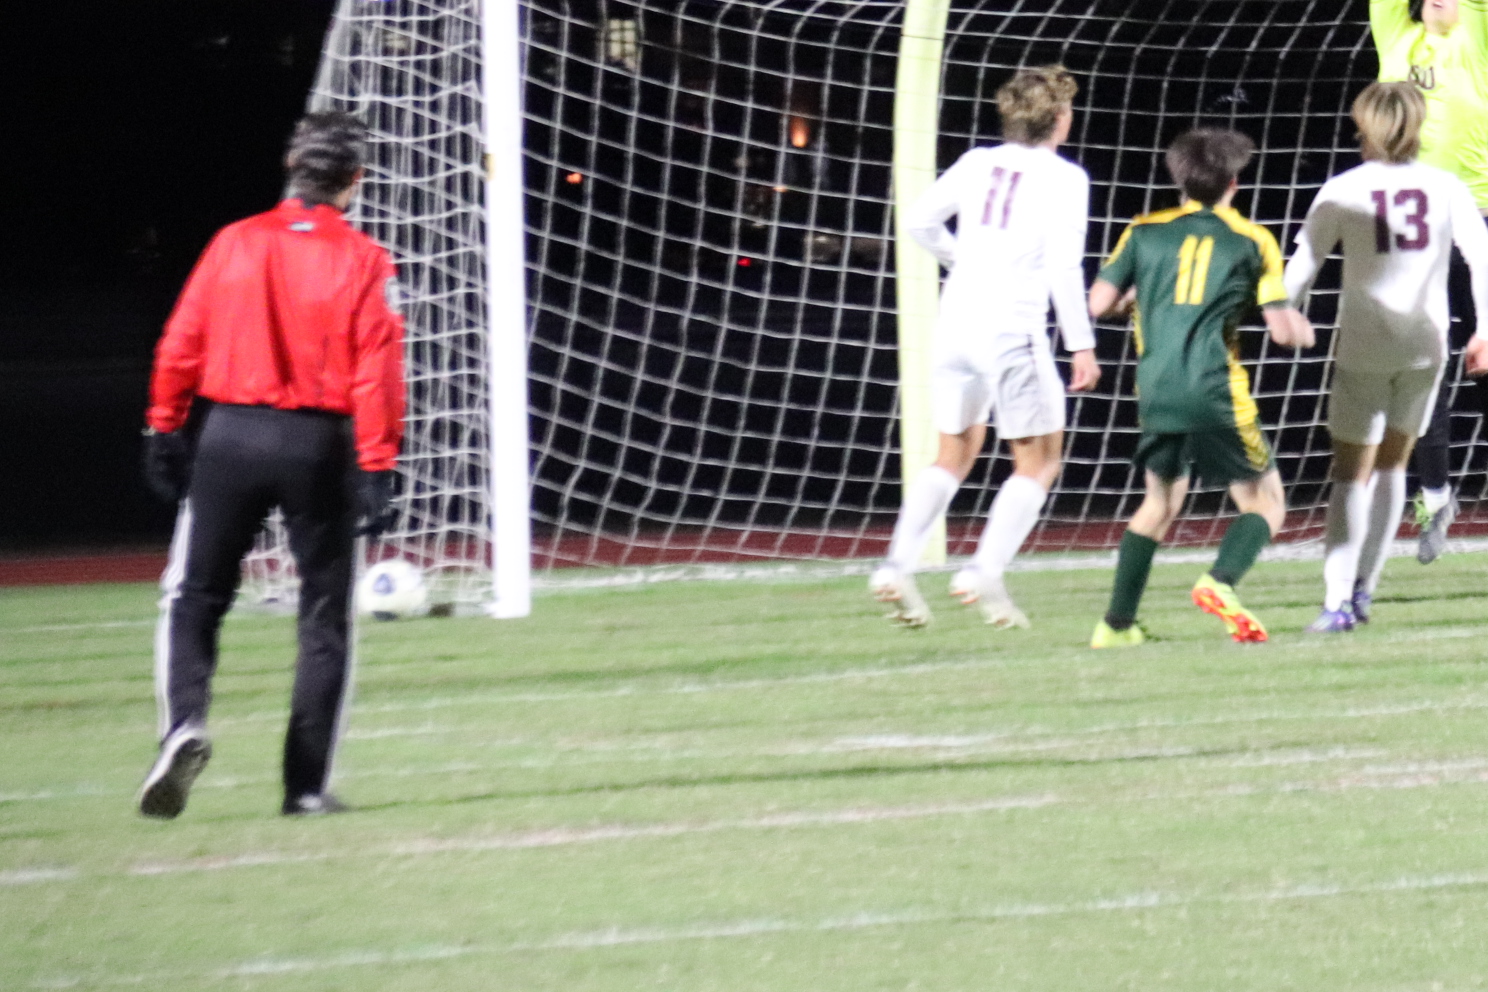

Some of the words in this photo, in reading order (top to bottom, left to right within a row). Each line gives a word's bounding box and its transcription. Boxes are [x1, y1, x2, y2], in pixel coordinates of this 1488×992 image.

[980, 166, 1022, 230] 11
[1370, 189, 1429, 254] 13
[1174, 234, 1214, 306] 11
